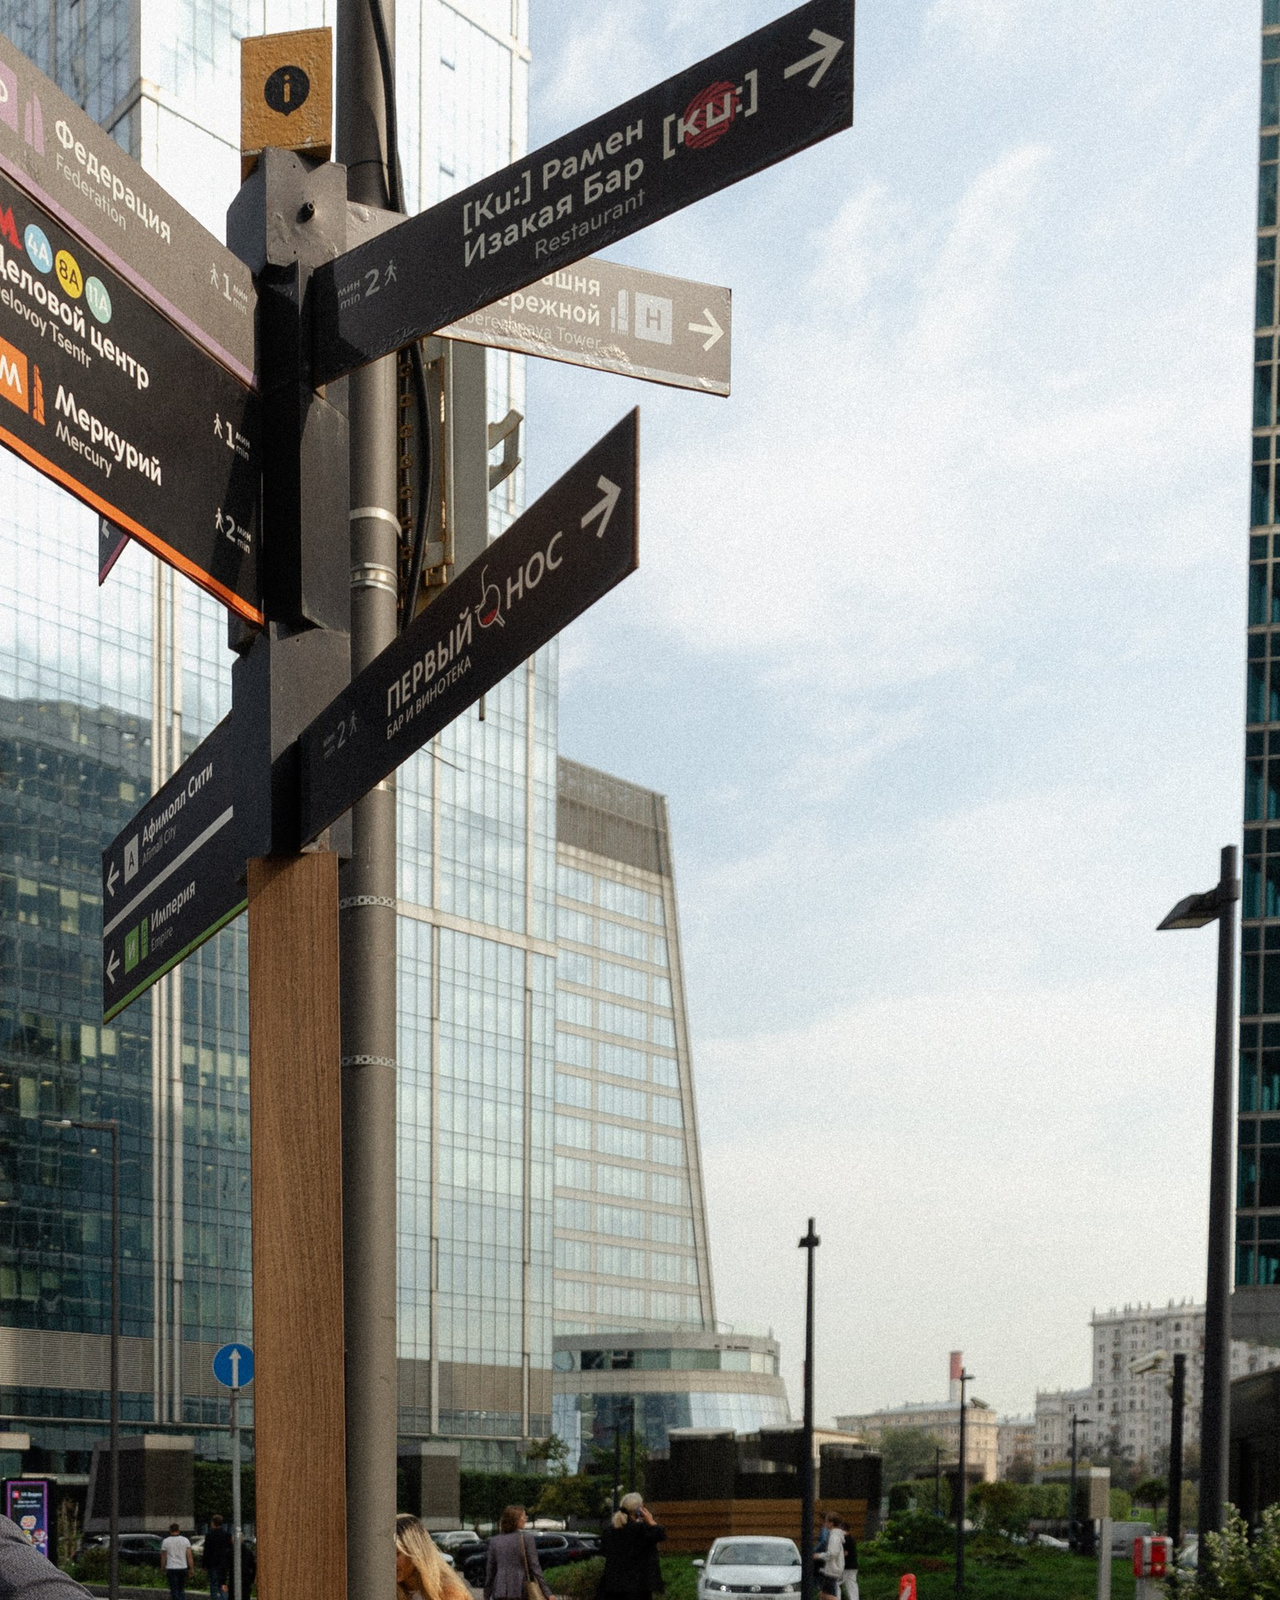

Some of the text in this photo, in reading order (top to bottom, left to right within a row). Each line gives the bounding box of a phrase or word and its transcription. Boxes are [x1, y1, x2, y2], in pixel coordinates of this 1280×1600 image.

[55, 119, 171, 245] Федерация
[56, 152, 127, 231] Federation
[462, 118, 643, 236] [Ku:] Рамен
[464, 157, 645, 268] Изакая Бар
[534, 188, 646, 260] Restaurant
[223, 272, 232, 301] 1
[337, 268, 381, 299] мин 2
[340, 293, 361, 310] min
[498, 292, 600, 327] ережной
[542, 270, 600, 297] ашня
[49, 320, 92, 369] Tsentr
[90, 325, 150, 390] центр
[555, 326, 602, 349] Tower
[54, 384, 162, 487] Меркурий
[55, 420, 112, 479] Mercury
[226, 420, 236, 450] 1
[225, 515, 236, 543] 2
[387, 530, 564, 718] ПЕРВЫЙ НОС
[386, 655, 472, 741] БАР И ВИНОТЕКА
[337, 720, 346, 749] 2
[142, 762, 213, 847] Афимолл Сити
[151, 880, 196, 932] Империя
